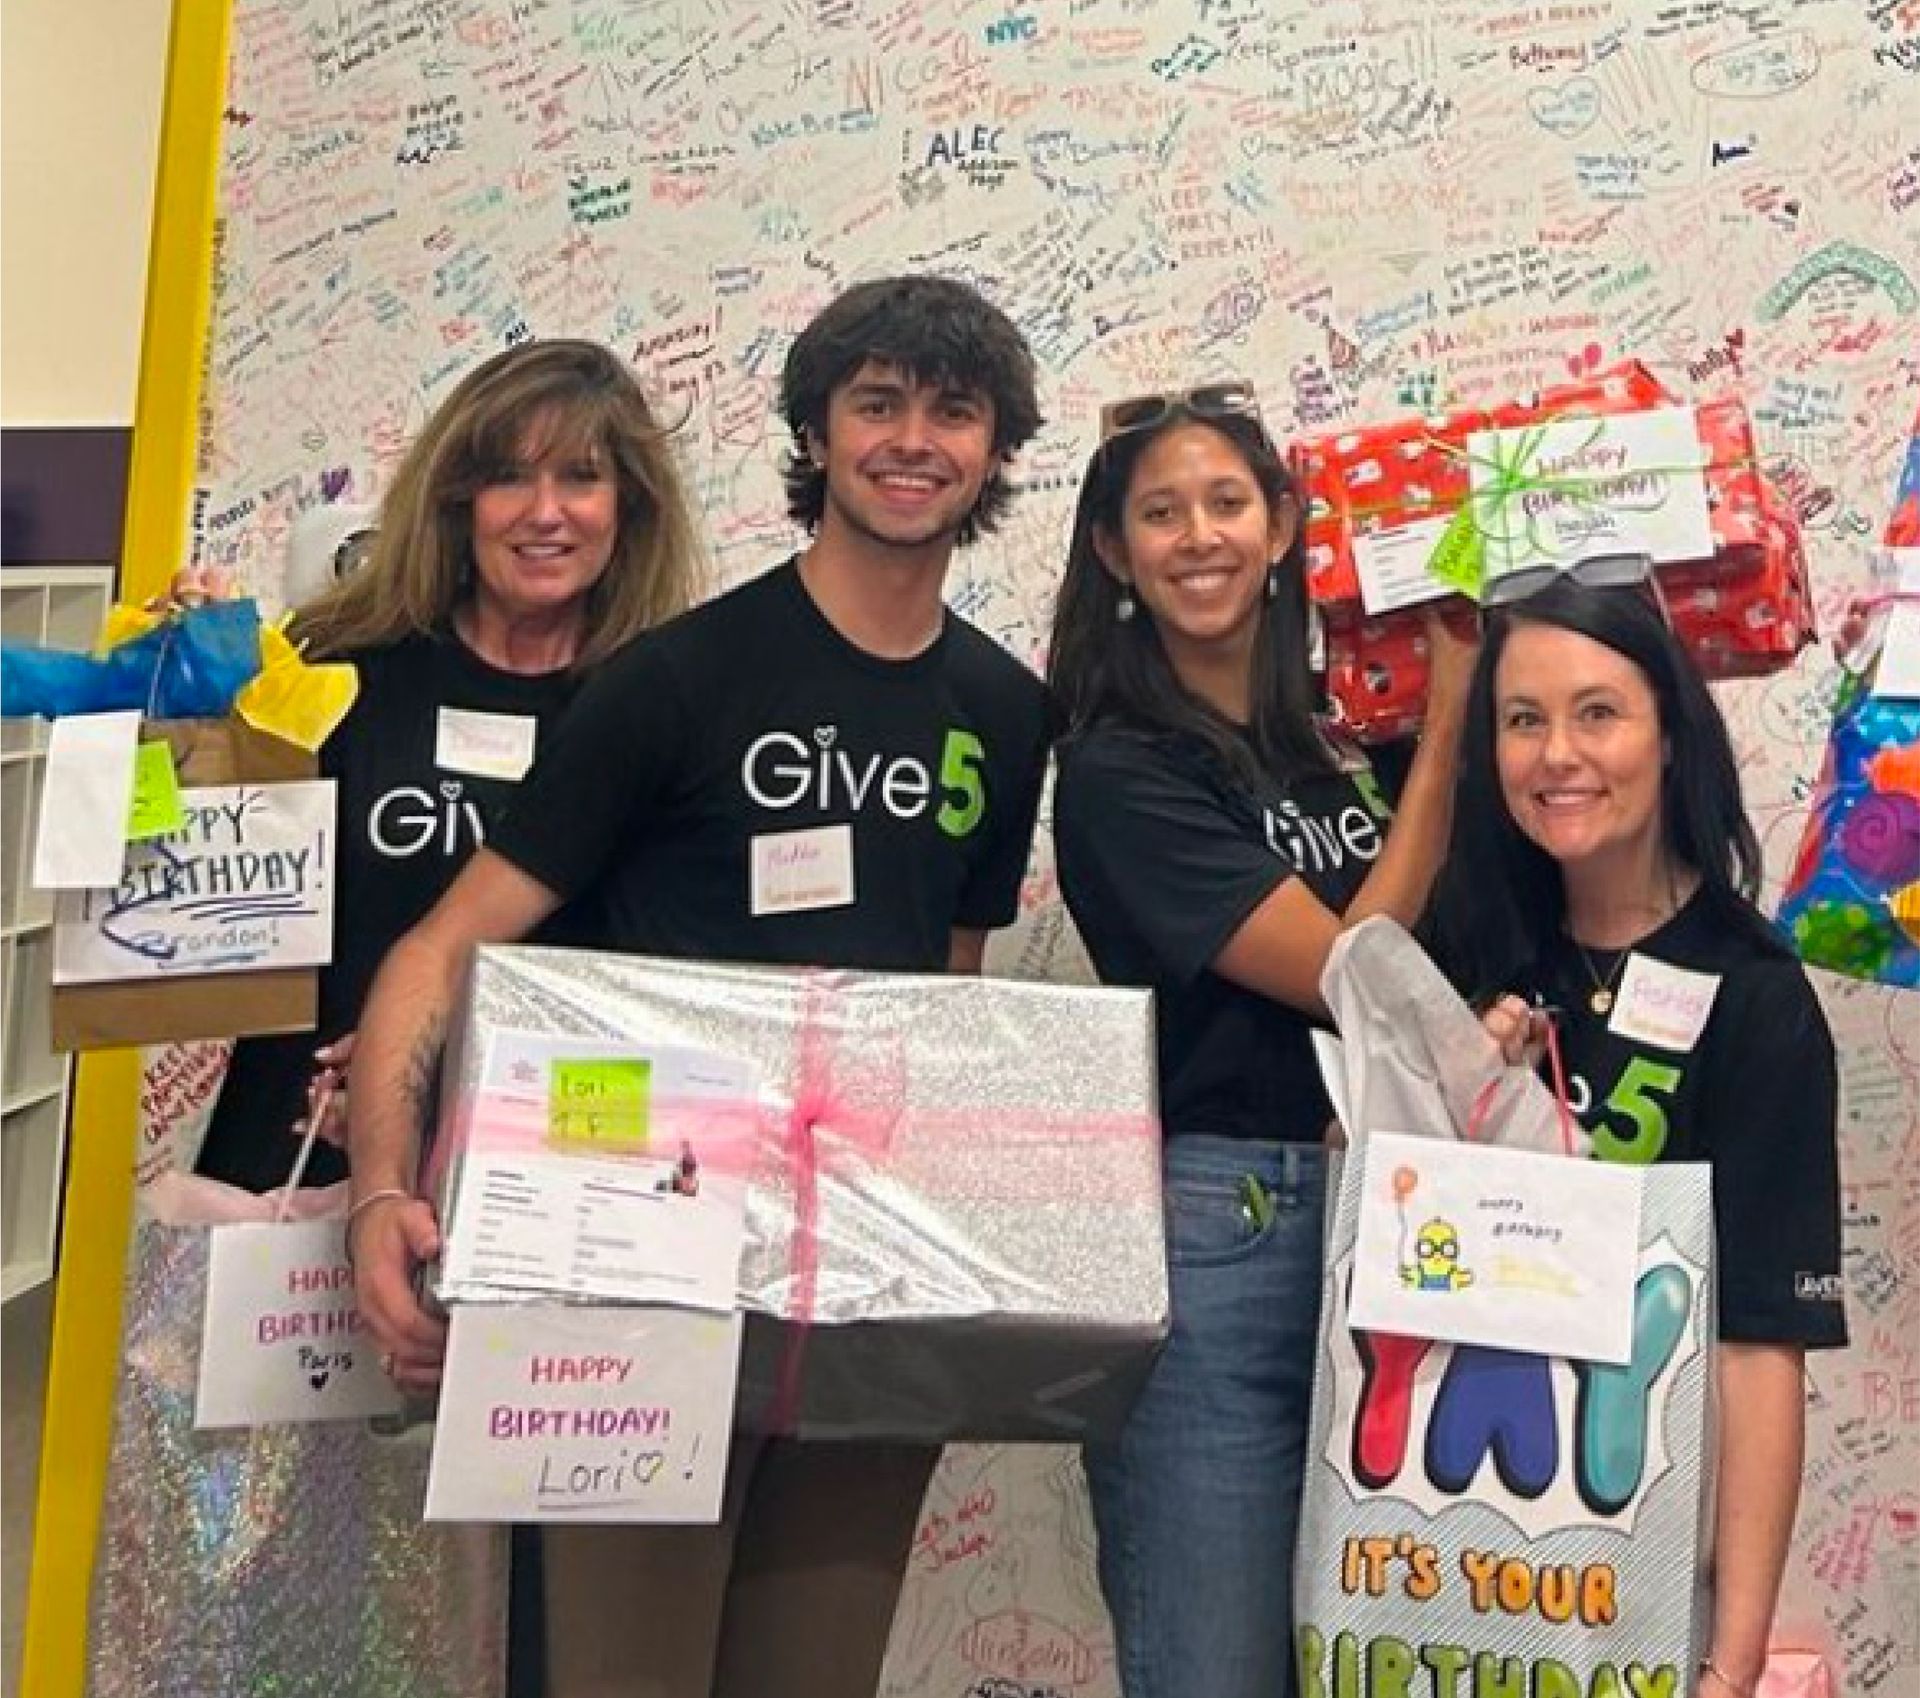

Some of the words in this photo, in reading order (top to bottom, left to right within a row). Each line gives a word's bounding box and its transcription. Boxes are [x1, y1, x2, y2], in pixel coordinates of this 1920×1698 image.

[926, 124, 1005, 167] ALEC
[531, 1355, 635, 1385] HAPPY
[489, 1406, 670, 1441] BIRTHDAY!
[1341, 1536, 1440, 1600] IT'S
[1460, 1549, 1619, 1628] YOUR
